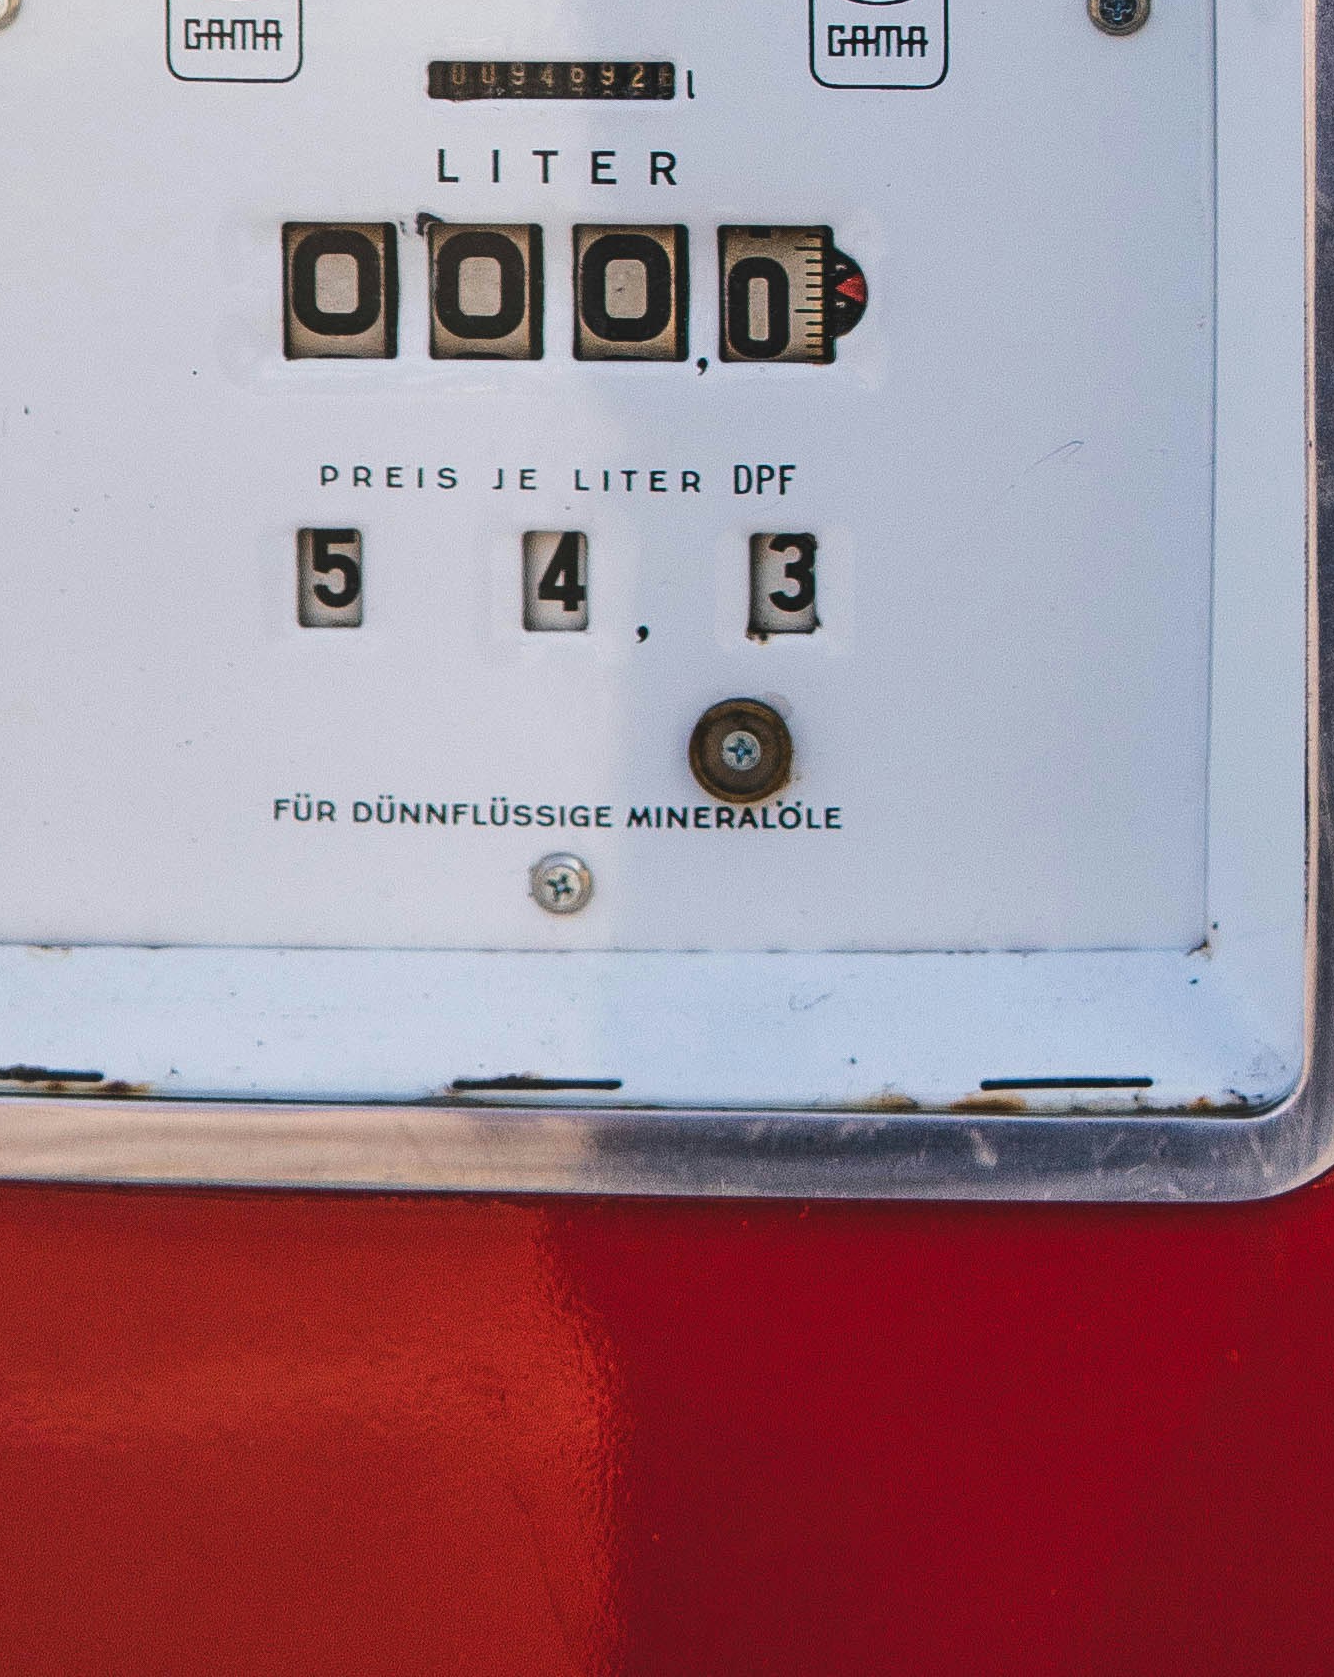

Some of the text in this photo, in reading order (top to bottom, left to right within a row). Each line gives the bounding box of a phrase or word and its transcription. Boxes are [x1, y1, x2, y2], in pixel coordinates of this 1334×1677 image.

[184, 18, 283, 51] GAMA
[827, 24, 929, 58] GAMA
[437, 148, 679, 187] LITER
[319, 464, 797, 497] PREIS JE LITER DPF
[273, 792, 843, 831] FÜR DÜNNFLÜSSIGE MINERALÖLE
